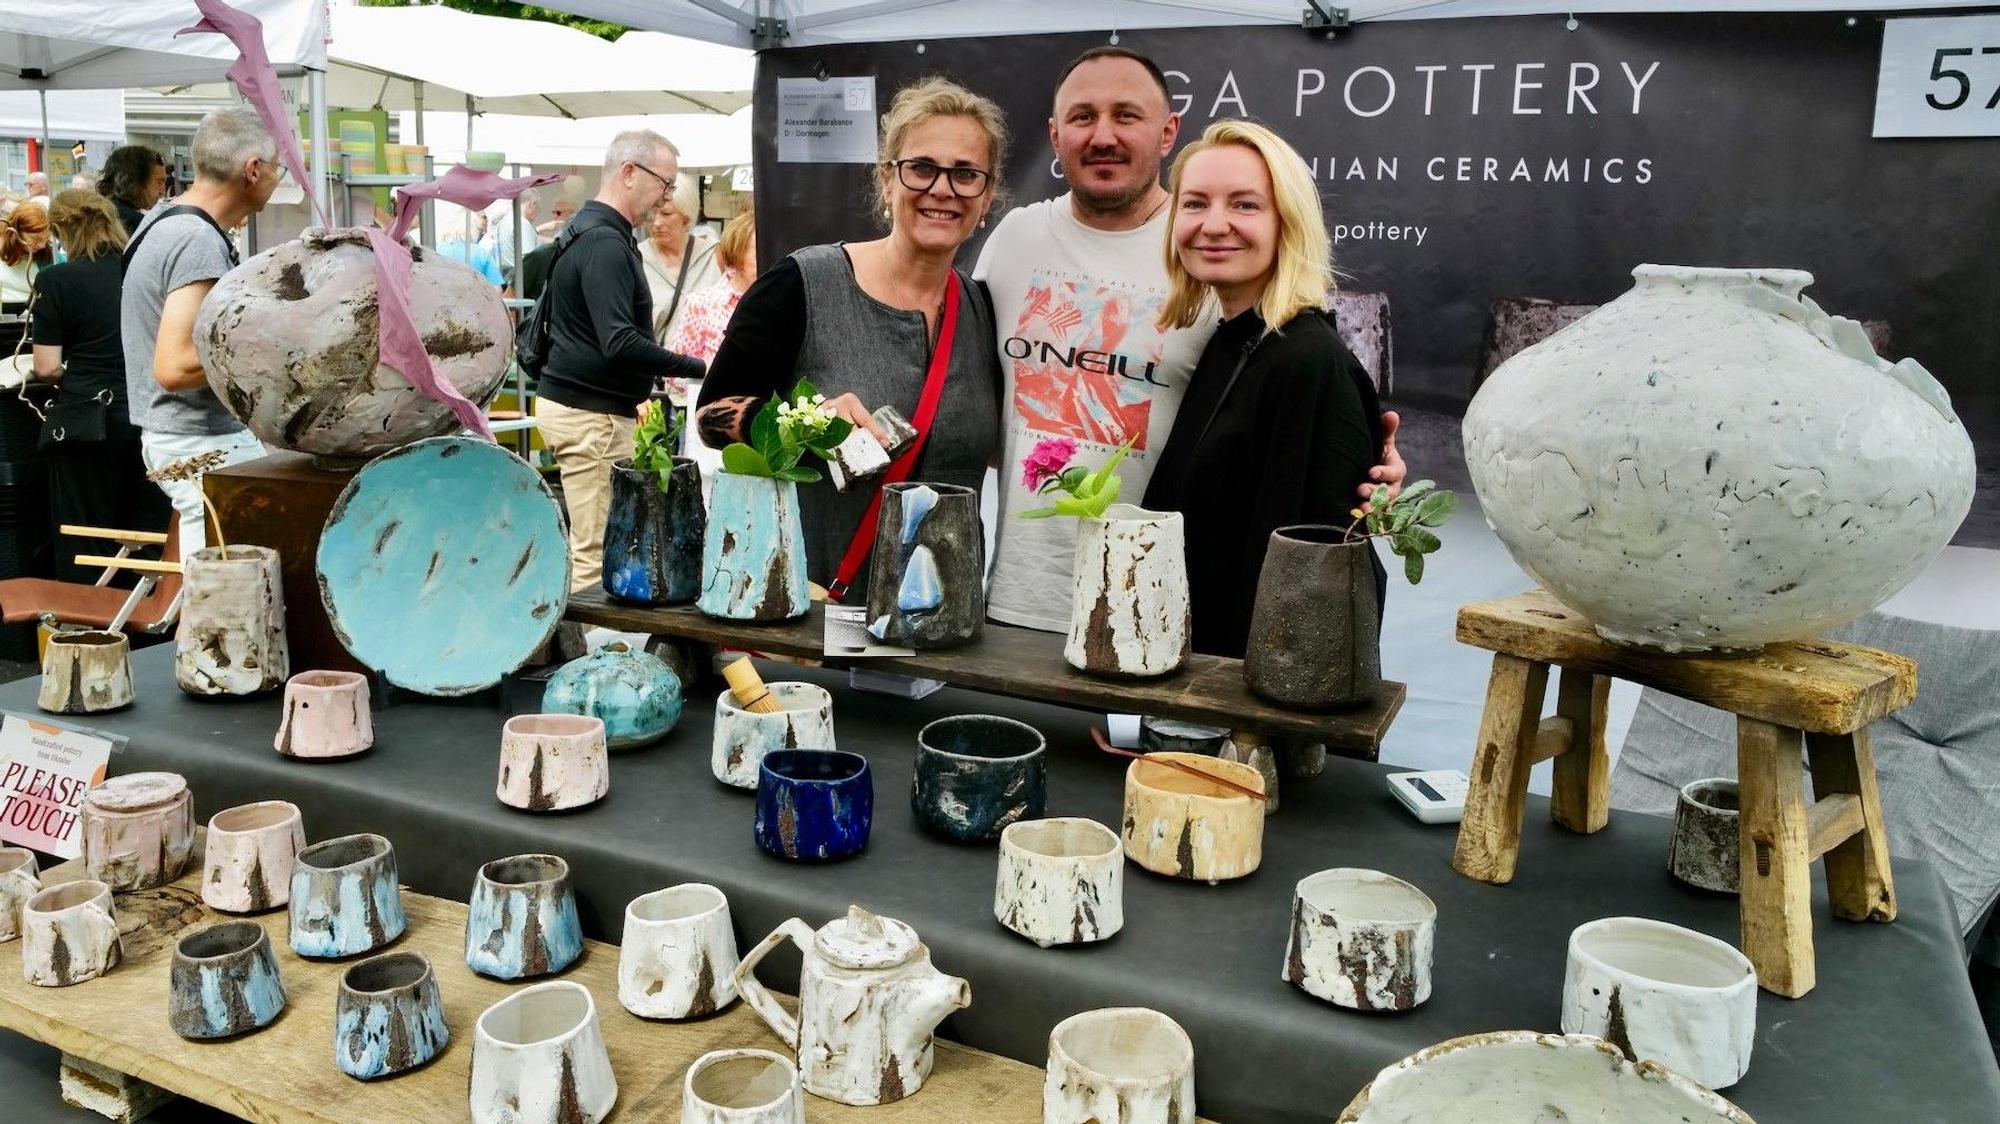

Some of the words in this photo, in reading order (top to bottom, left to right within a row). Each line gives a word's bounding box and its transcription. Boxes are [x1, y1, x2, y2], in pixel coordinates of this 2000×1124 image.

[847, 87, 867, 107] 57
[1163, 70, 1248, 118] GA
[1295, 61, 1661, 118] POTTERY
[1426, 157, 1653, 185] CERAMICS
[1334, 221, 1428, 247] pottery
[1033, 268, 1067, 278] FIRST
[1076, 273, 1089, 281] IN
[1100, 278, 1137, 289] LAST
[1148, 286, 1167, 295] OU
[1004, 337, 1171, 388] O'NEILL
[1075, 442, 1107, 454] ANTA
[0, 762, 87, 809] PLEASE
[0, 794, 78, 842] TOUCH
